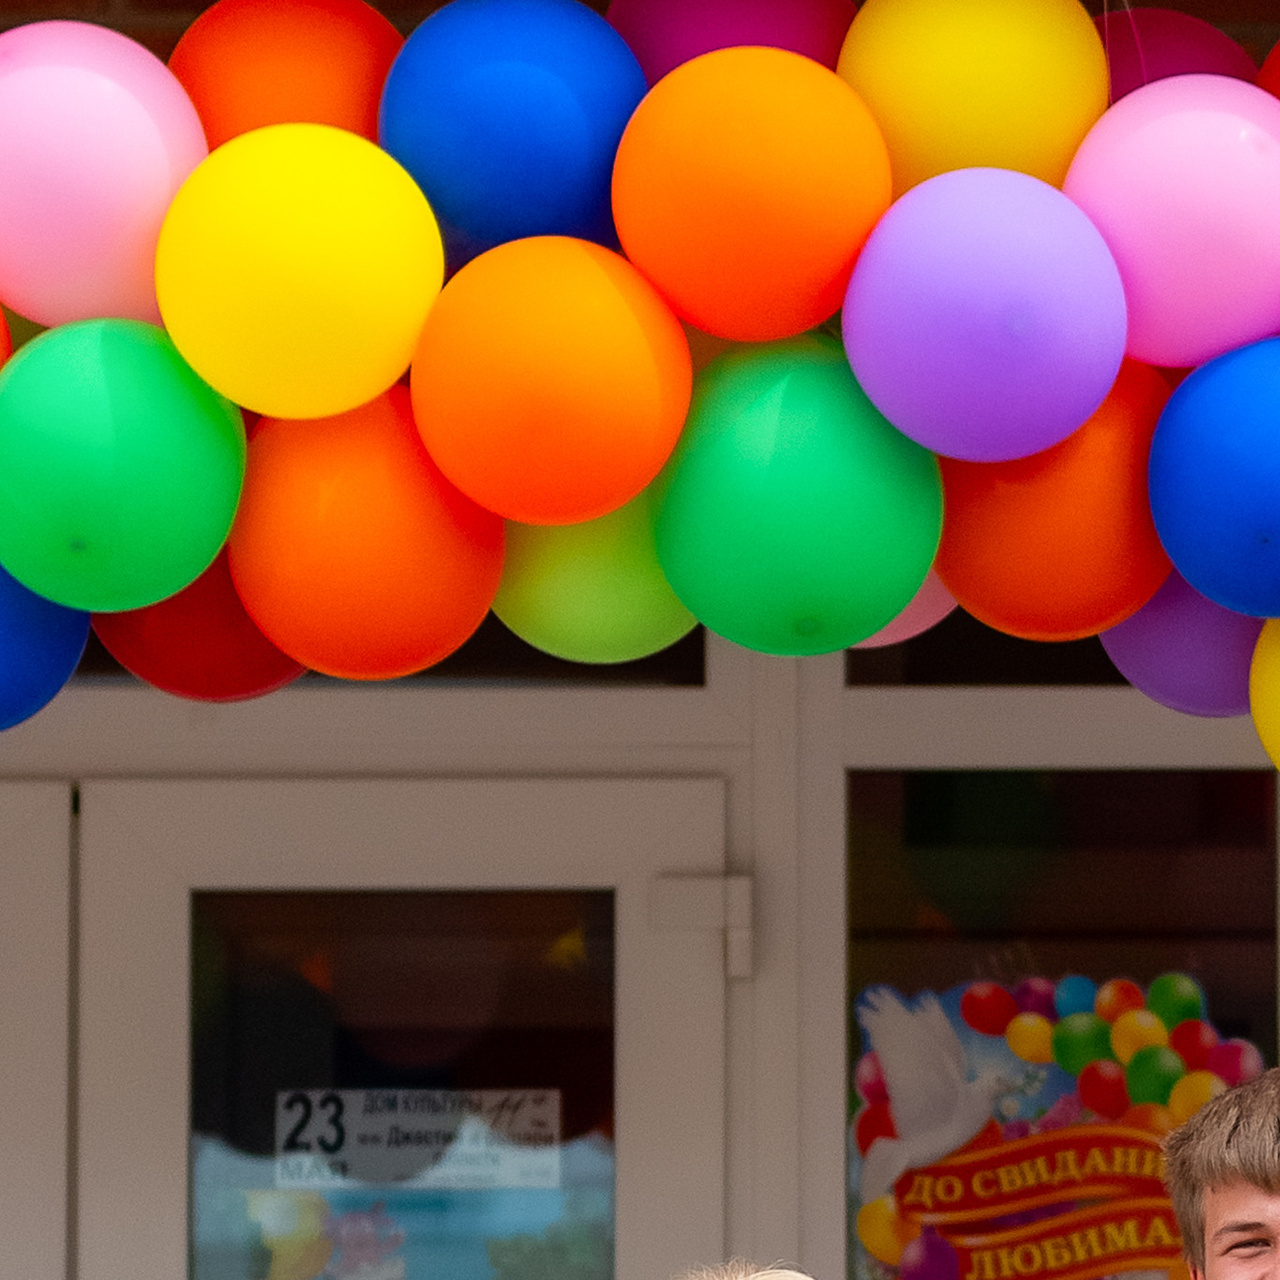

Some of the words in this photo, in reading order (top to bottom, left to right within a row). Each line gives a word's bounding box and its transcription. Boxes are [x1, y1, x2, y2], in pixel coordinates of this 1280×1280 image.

[283, 1093, 346, 1153] 23
[903, 1175, 964, 1208] ДО
[971, 1147, 1167, 1199] СВИДАНИ
